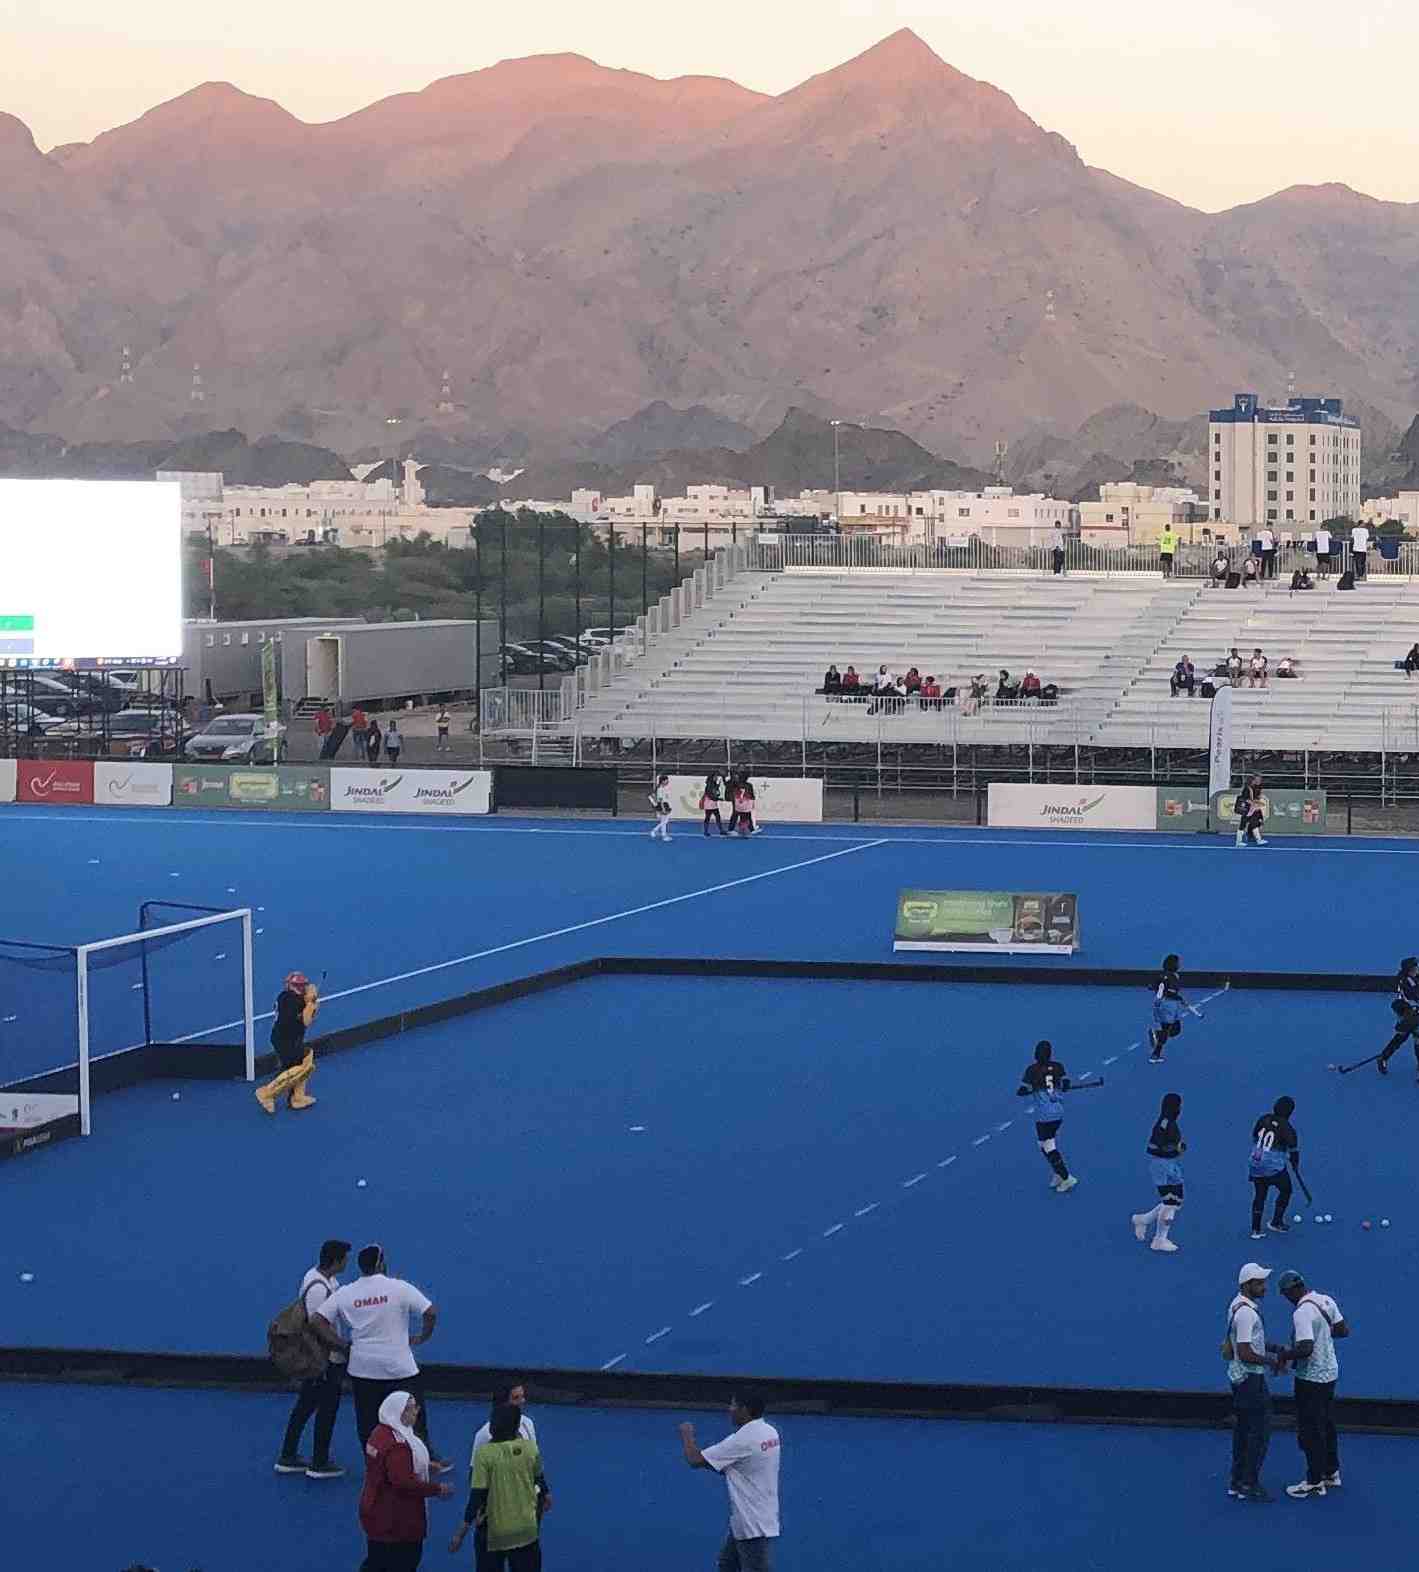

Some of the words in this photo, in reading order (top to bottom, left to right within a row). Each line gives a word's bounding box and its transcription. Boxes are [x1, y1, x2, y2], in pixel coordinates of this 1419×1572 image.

[344, 785, 385, 797] JINDAL
[413, 787, 454, 798] JINDAL
[1040, 804, 1083, 816] JINDAL
[1045, 1074, 1054, 1093] 5
[1256, 1127, 1275, 1152] 10
[353, 1295, 389, 1309] OMAN
